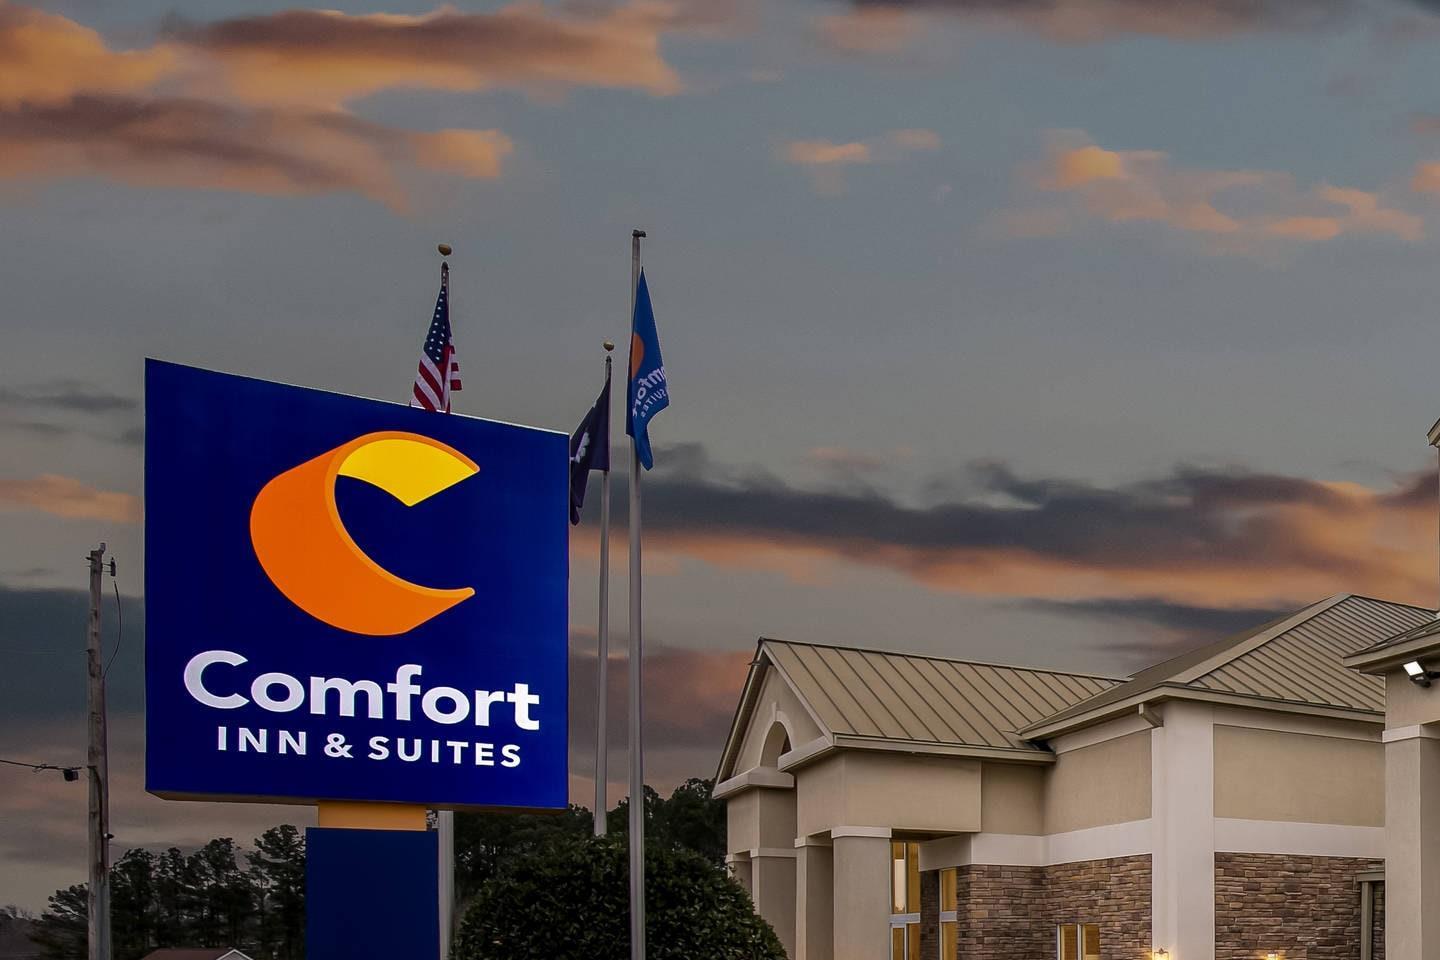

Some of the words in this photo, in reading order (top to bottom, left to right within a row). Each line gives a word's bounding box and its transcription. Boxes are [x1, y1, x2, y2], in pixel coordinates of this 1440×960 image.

[183, 649, 540, 731] Comfort
[217, 725, 307, 756] INN
[323, 732, 354, 759] &
[367, 735, 521, 768] SUITES
